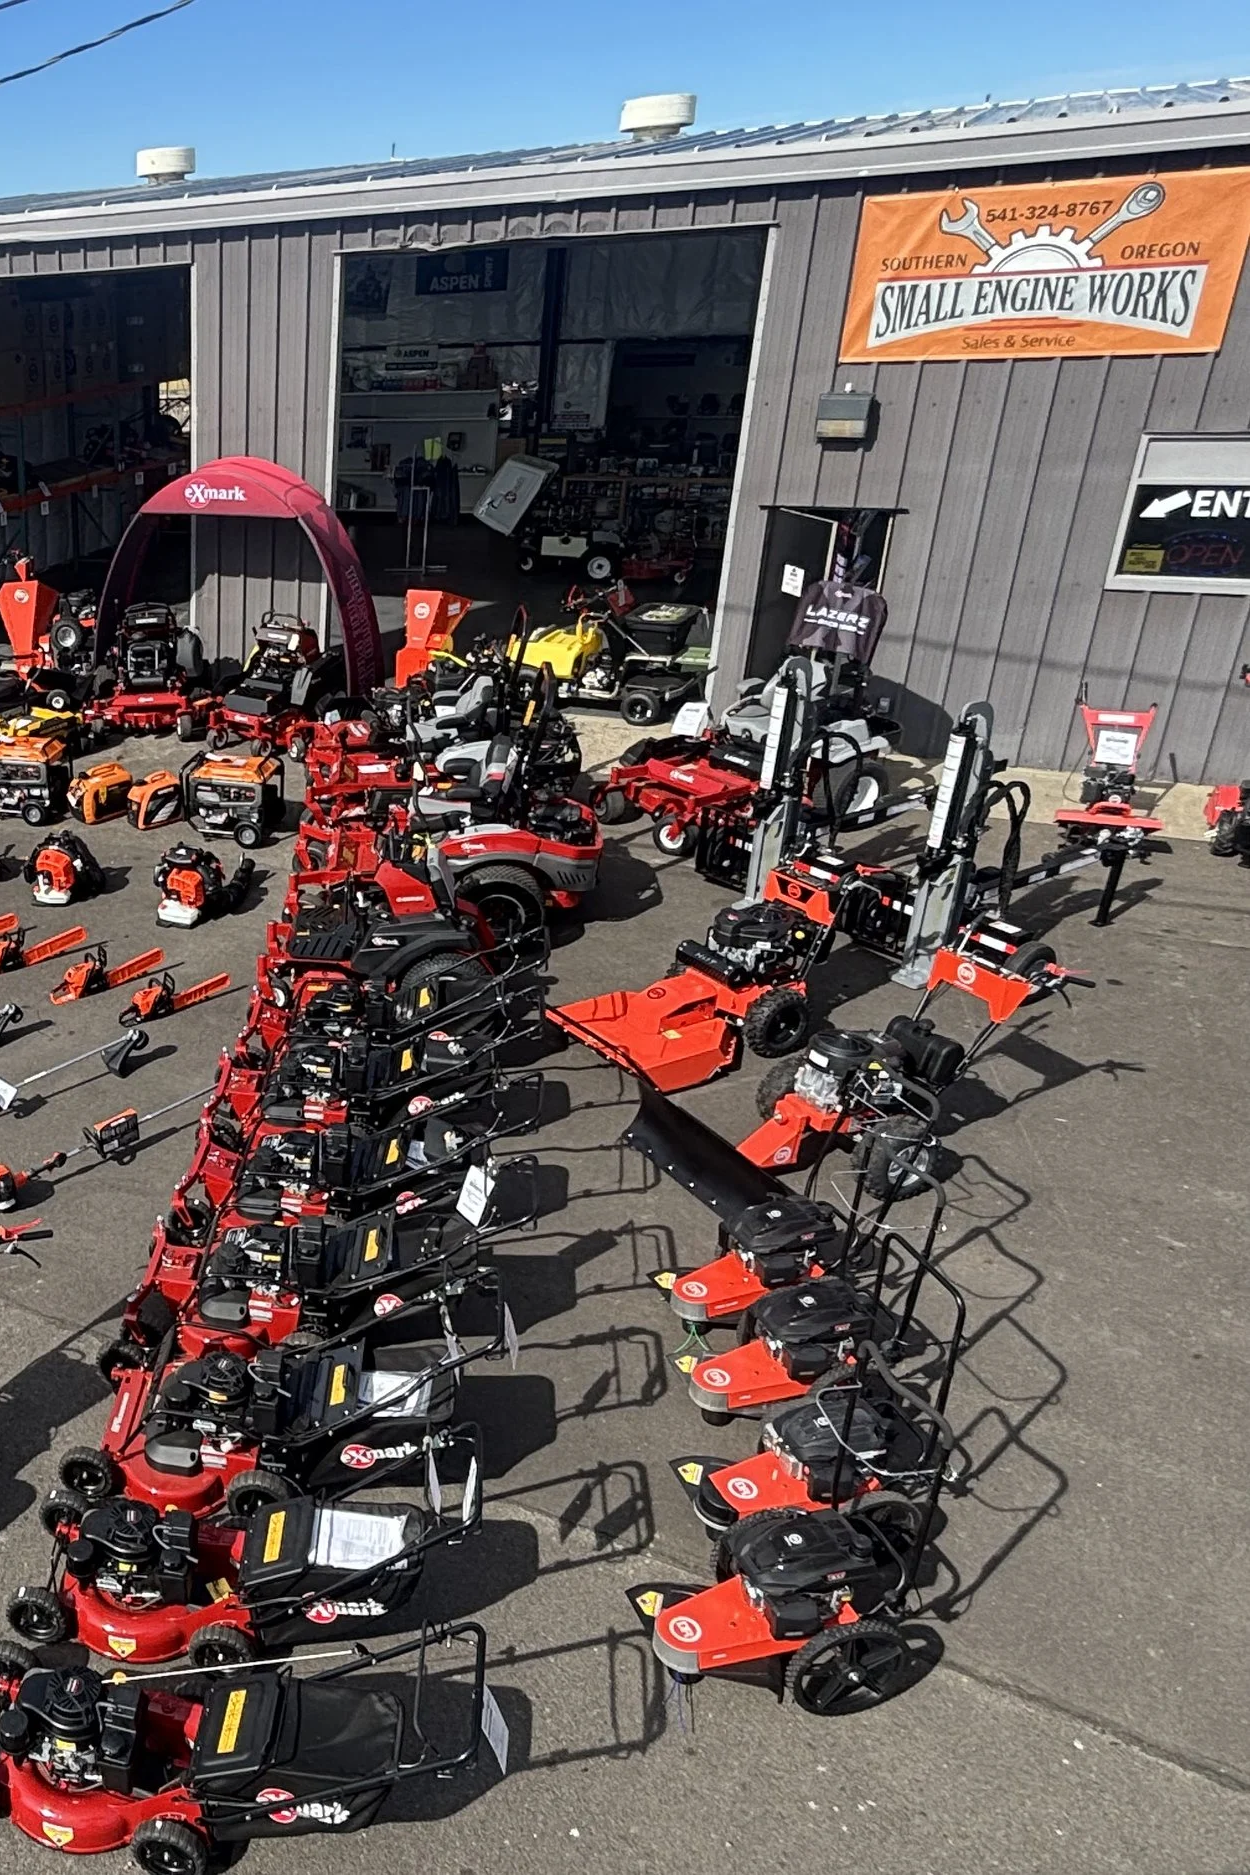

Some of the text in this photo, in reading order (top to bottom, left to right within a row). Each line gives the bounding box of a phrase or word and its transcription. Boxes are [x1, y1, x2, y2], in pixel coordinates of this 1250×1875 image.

[986, 200, 1114, 223] 541-324-8767
[881, 241, 1201, 272] SOUTHERN OREGON
[429, 274, 481, 292] ASPEN
[875, 269, 1198, 339] SMALL ENGINE WORKS
[961, 333, 1076, 351] Sales & Service
[184, 483, 248, 503] eXmark
[1167, 543, 1245, 566] OPEN
